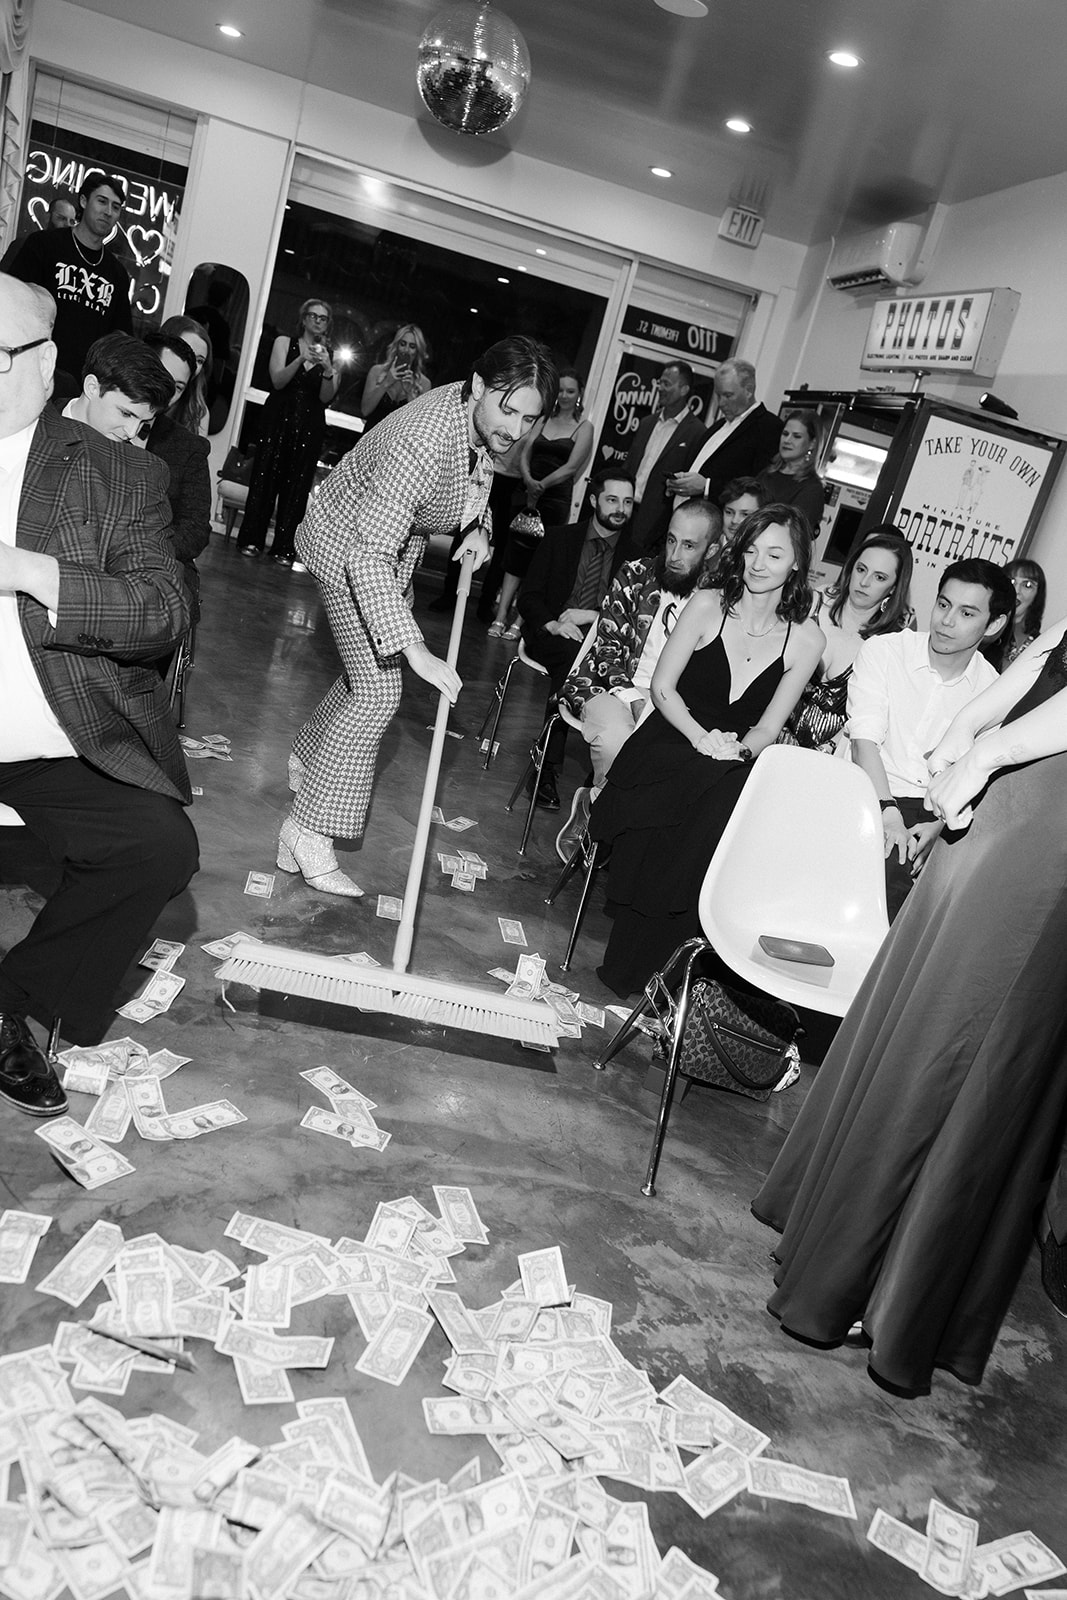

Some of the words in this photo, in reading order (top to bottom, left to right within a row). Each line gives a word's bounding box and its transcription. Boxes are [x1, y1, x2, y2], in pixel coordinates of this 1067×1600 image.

[727, 211, 761, 242] EXIT
[880, 297, 974, 350] PHOTOS
[925, 436, 963, 456] TAKE
[970, 438, 1008, 464] YOUR
[1009, 455, 1041, 487] OWN
[898, 507, 1015, 567] PORTRAITS
[922, 504, 1000, 530] MINIATURE
